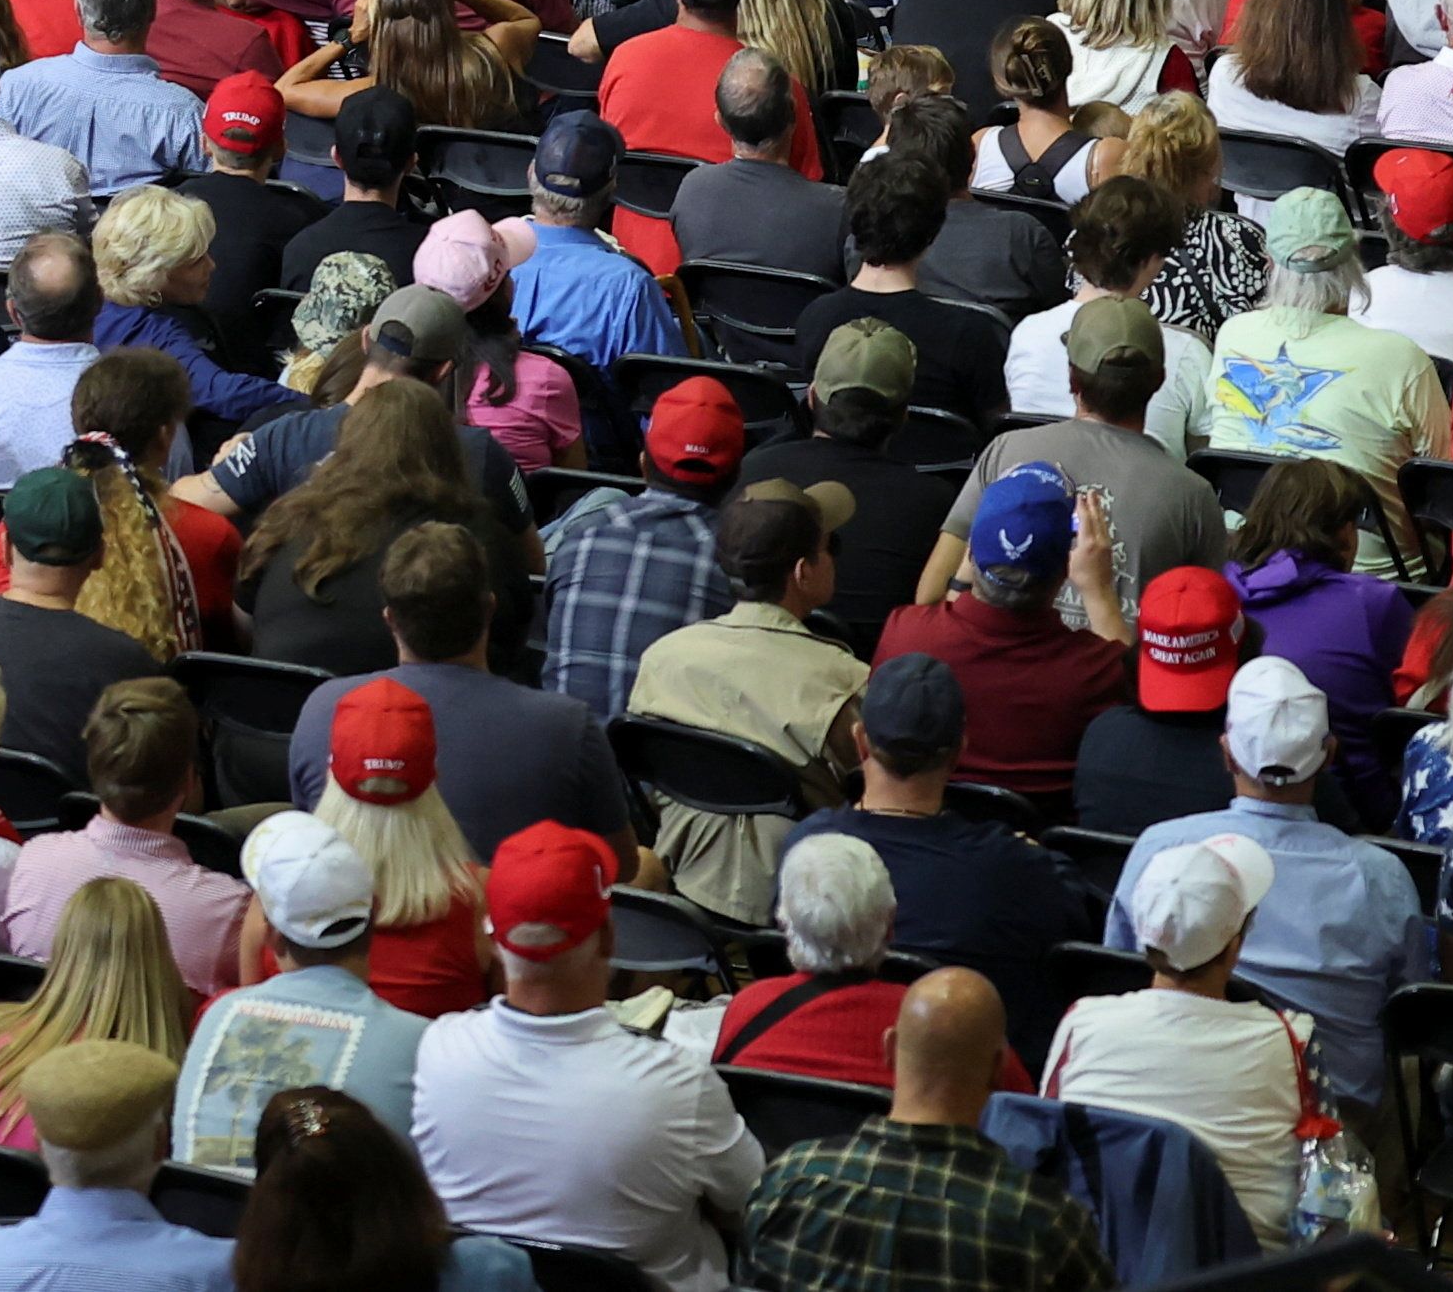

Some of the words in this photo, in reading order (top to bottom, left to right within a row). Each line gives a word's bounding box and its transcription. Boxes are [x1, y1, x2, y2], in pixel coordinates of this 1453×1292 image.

[223, 111, 261, 125] TRUMP
[1144, 631, 1171, 646] MAKE
[1172, 629, 1220, 644] AMERICA
[1149, 650, 1180, 665] GREAT
[1182, 646, 1217, 663] AGAIN
[363, 758, 405, 771] TRUMP
